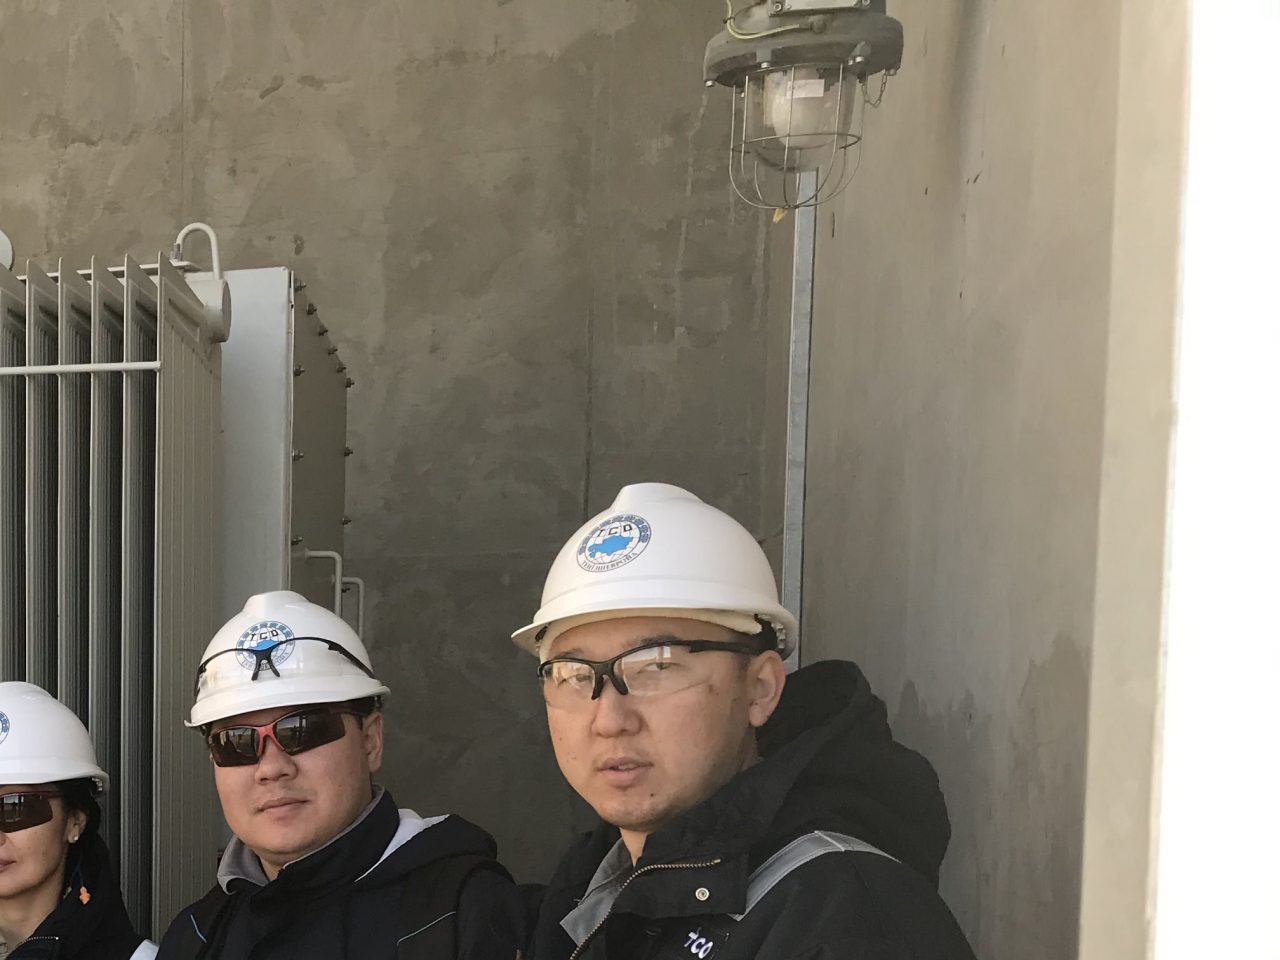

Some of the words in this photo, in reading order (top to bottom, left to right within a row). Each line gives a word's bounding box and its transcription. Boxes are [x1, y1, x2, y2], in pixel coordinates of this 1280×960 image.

[597, 523, 633, 538] TCO
[250, 629, 279, 642] TCO
[683, 931, 714, 959] TCO
